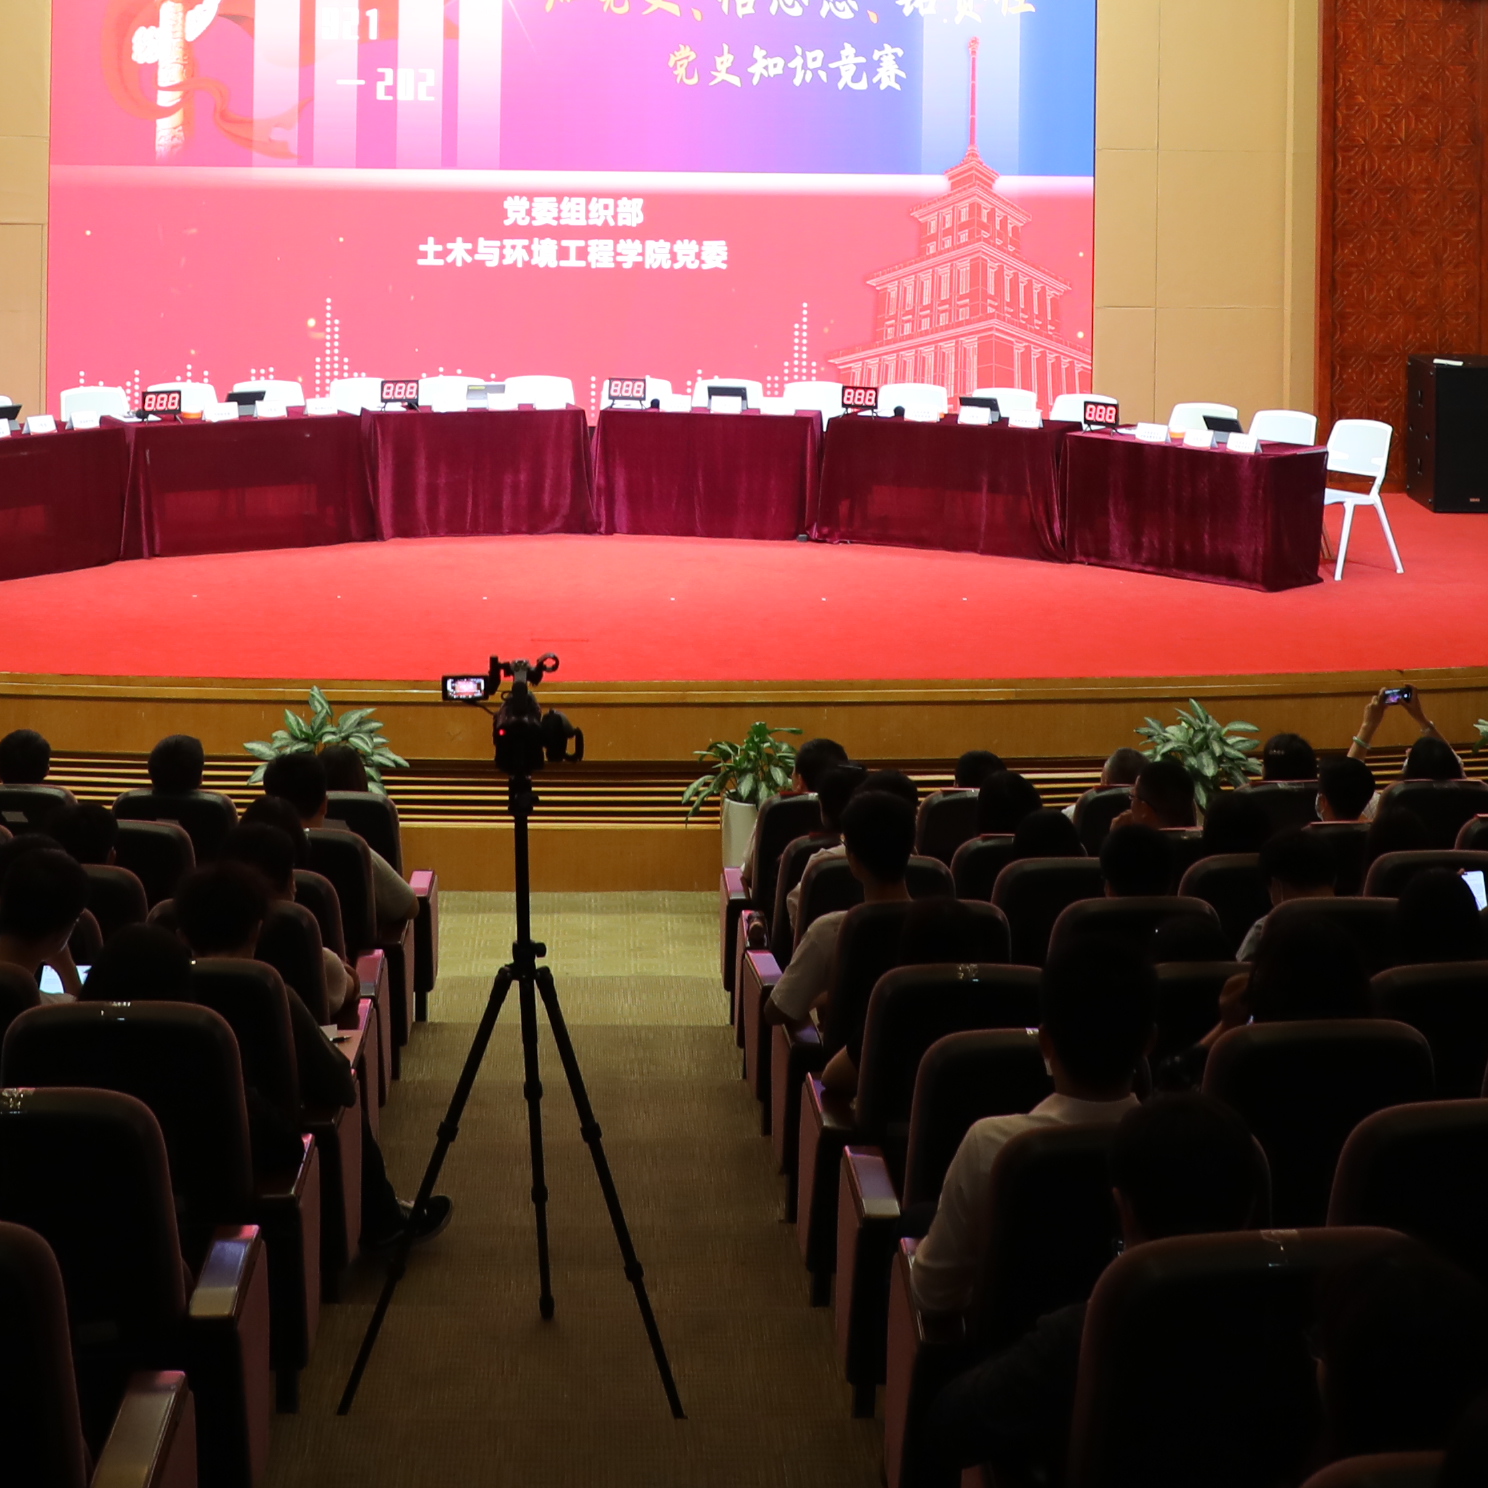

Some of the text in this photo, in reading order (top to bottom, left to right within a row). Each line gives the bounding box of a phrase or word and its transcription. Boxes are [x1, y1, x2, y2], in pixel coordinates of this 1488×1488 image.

[668, 42, 907, 91] 党史知识竞赛
[503, 196, 644, 227] 党委组织部
[416, 236, 728, 269] 土木与环境工程学院党委
